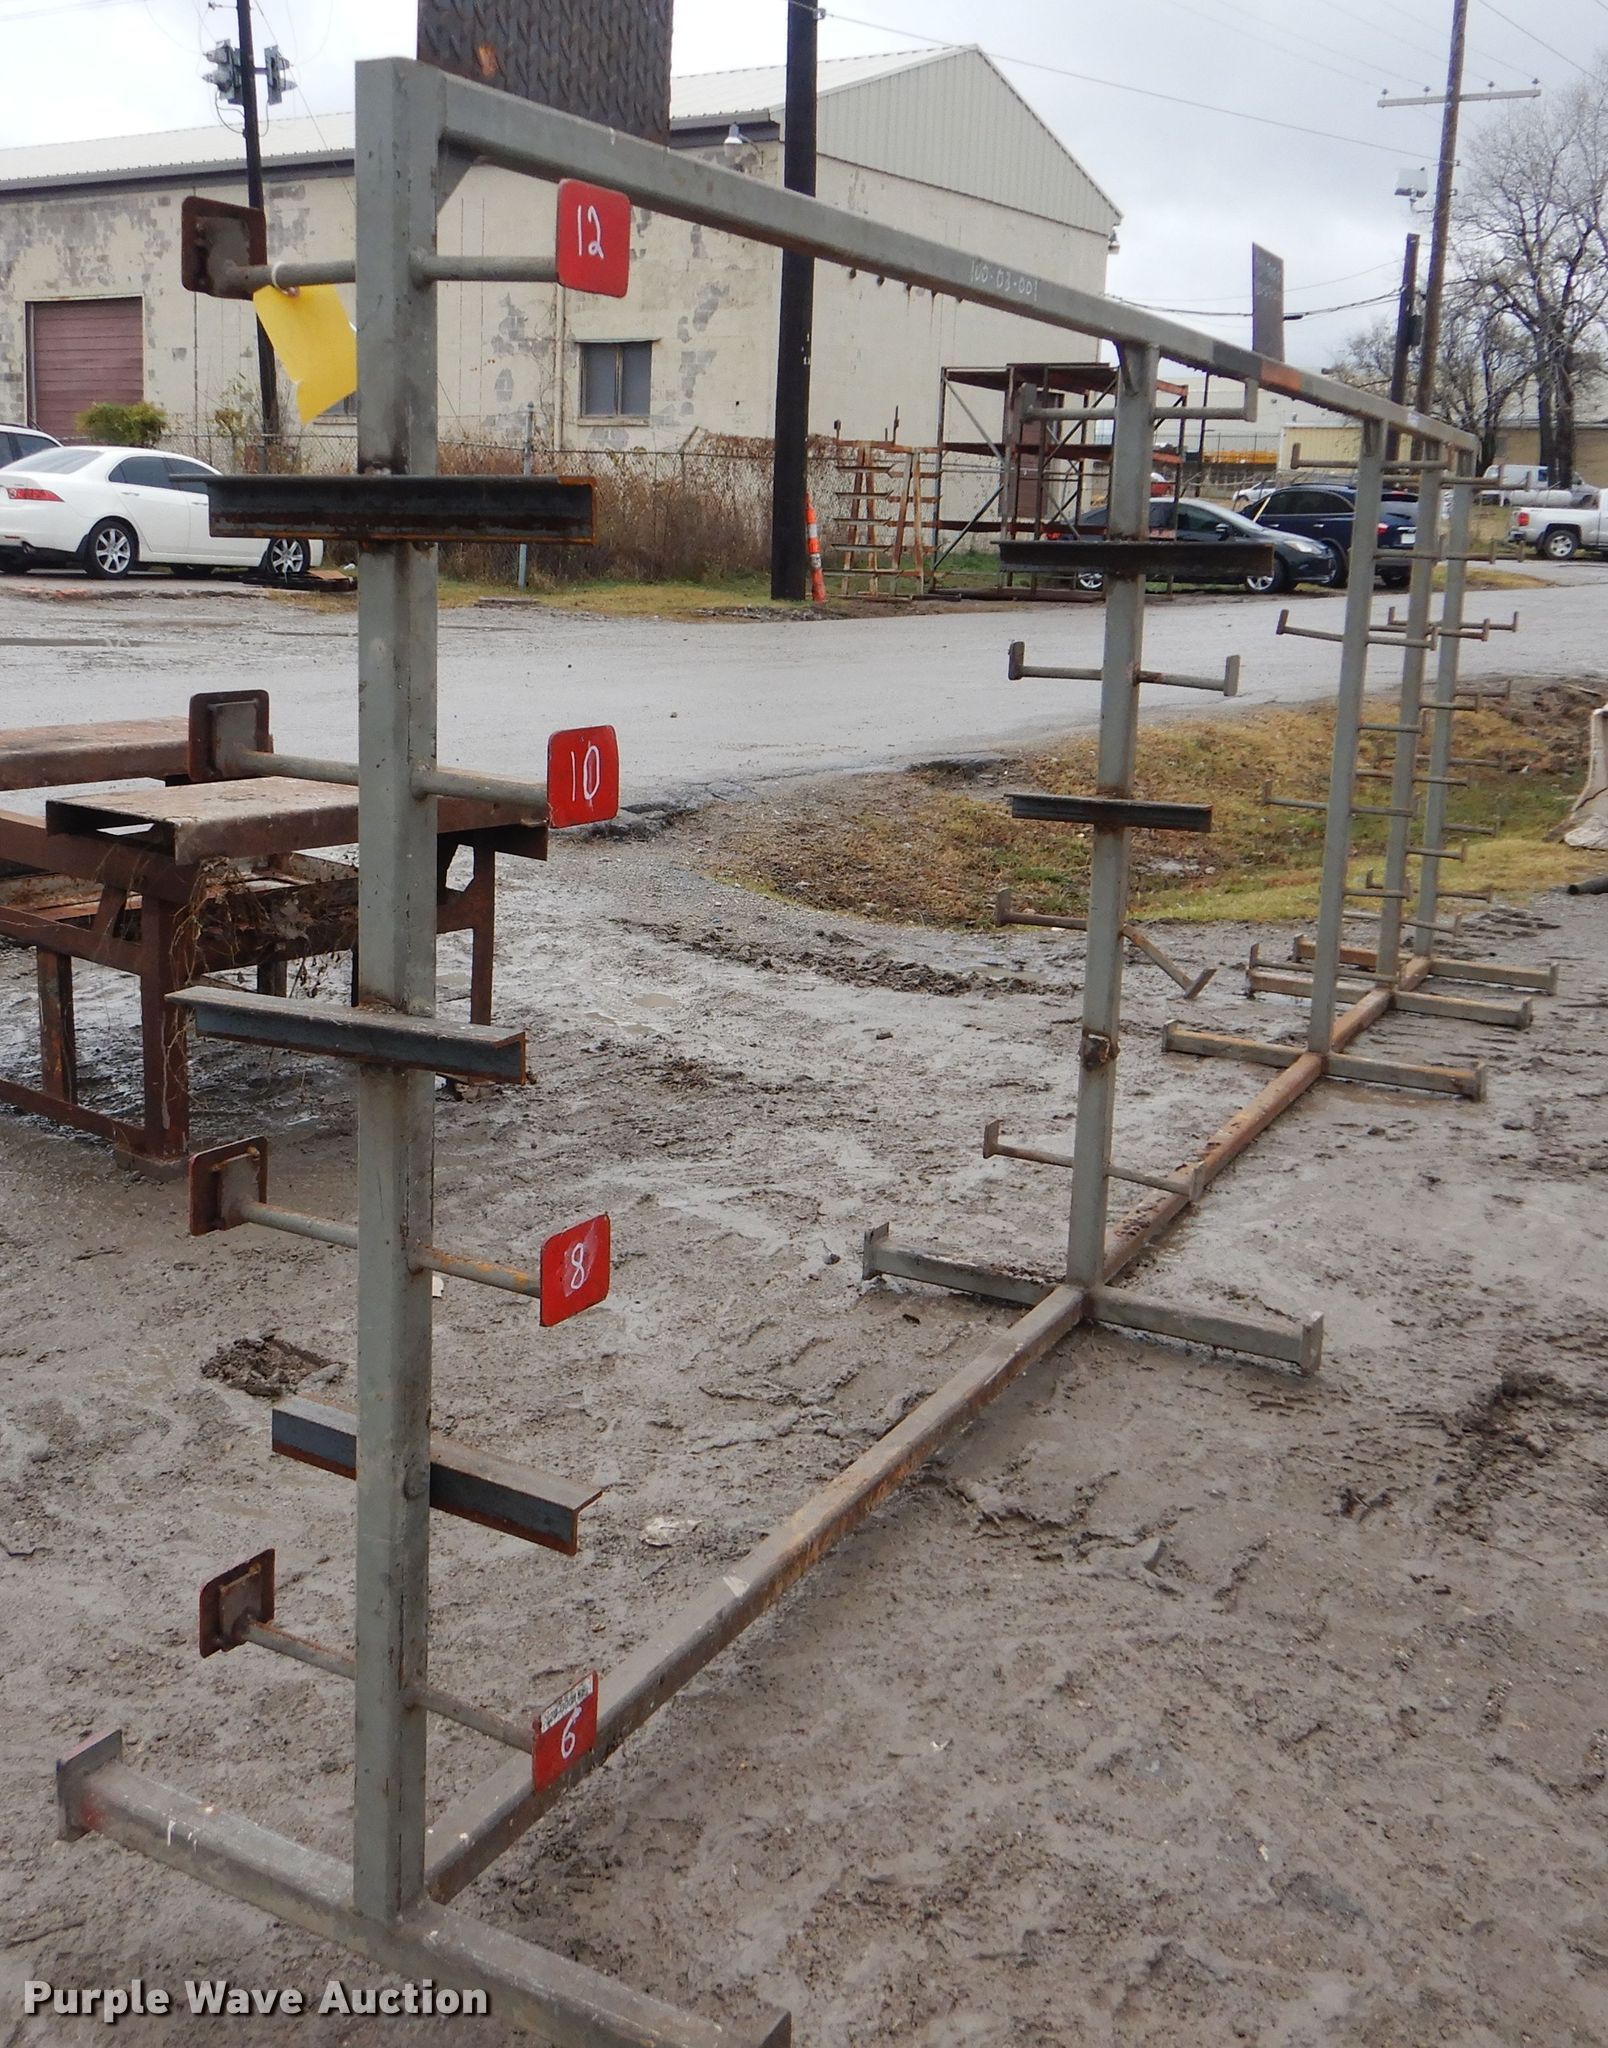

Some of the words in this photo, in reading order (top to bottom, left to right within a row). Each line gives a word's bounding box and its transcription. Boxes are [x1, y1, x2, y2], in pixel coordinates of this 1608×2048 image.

[577, 204, 604, 260] 12
[570, 744, 601, 803] 10
[570, 1242, 585, 1290] 8
[561, 1705, 582, 1760] 6
